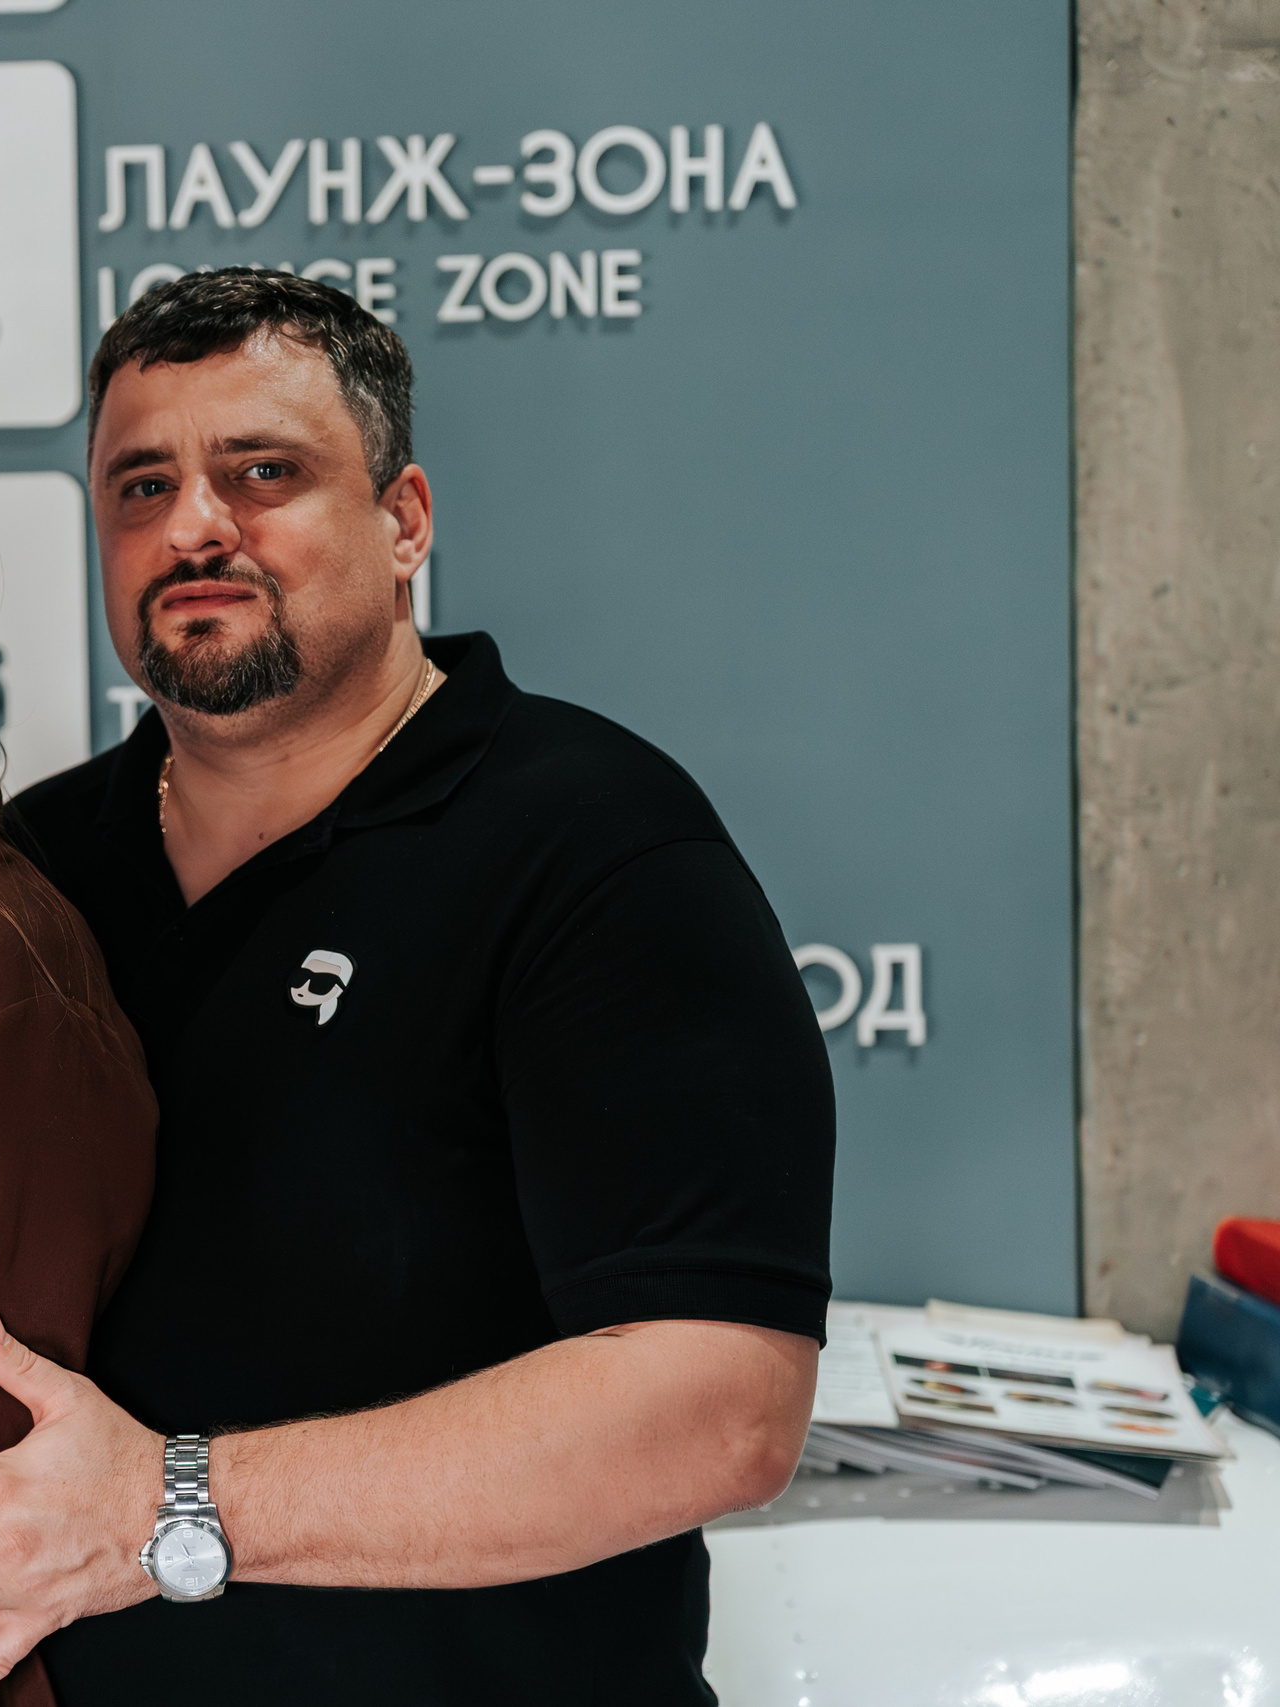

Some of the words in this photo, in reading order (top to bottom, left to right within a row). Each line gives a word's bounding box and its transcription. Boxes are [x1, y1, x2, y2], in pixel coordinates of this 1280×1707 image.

[98, 121, 797, 232] ЛАУНЖ-ЗОНА
[98, 257, 397, 331] LOE
[436, 249, 642, 322] ZONE
